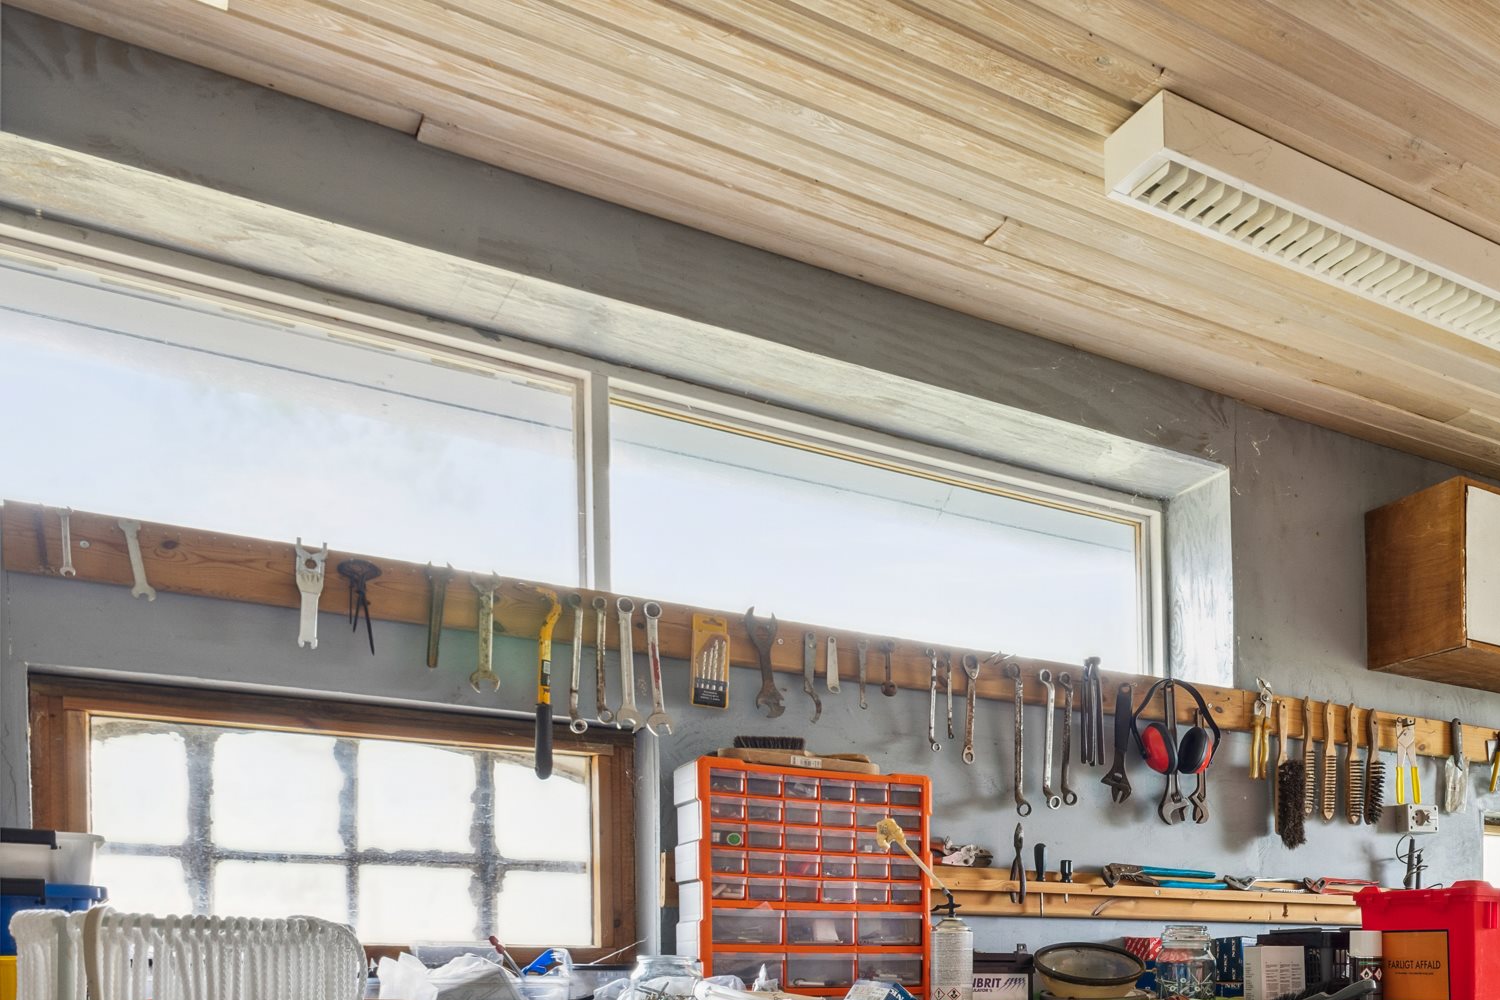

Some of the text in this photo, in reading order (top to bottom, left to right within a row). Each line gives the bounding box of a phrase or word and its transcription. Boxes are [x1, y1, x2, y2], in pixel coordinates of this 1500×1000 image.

[1388, 960, 1414, 969] FARLIGT
[1415, 960, 1441, 969] AFFALD
[972, 977, 1002, 988] IBRIT
